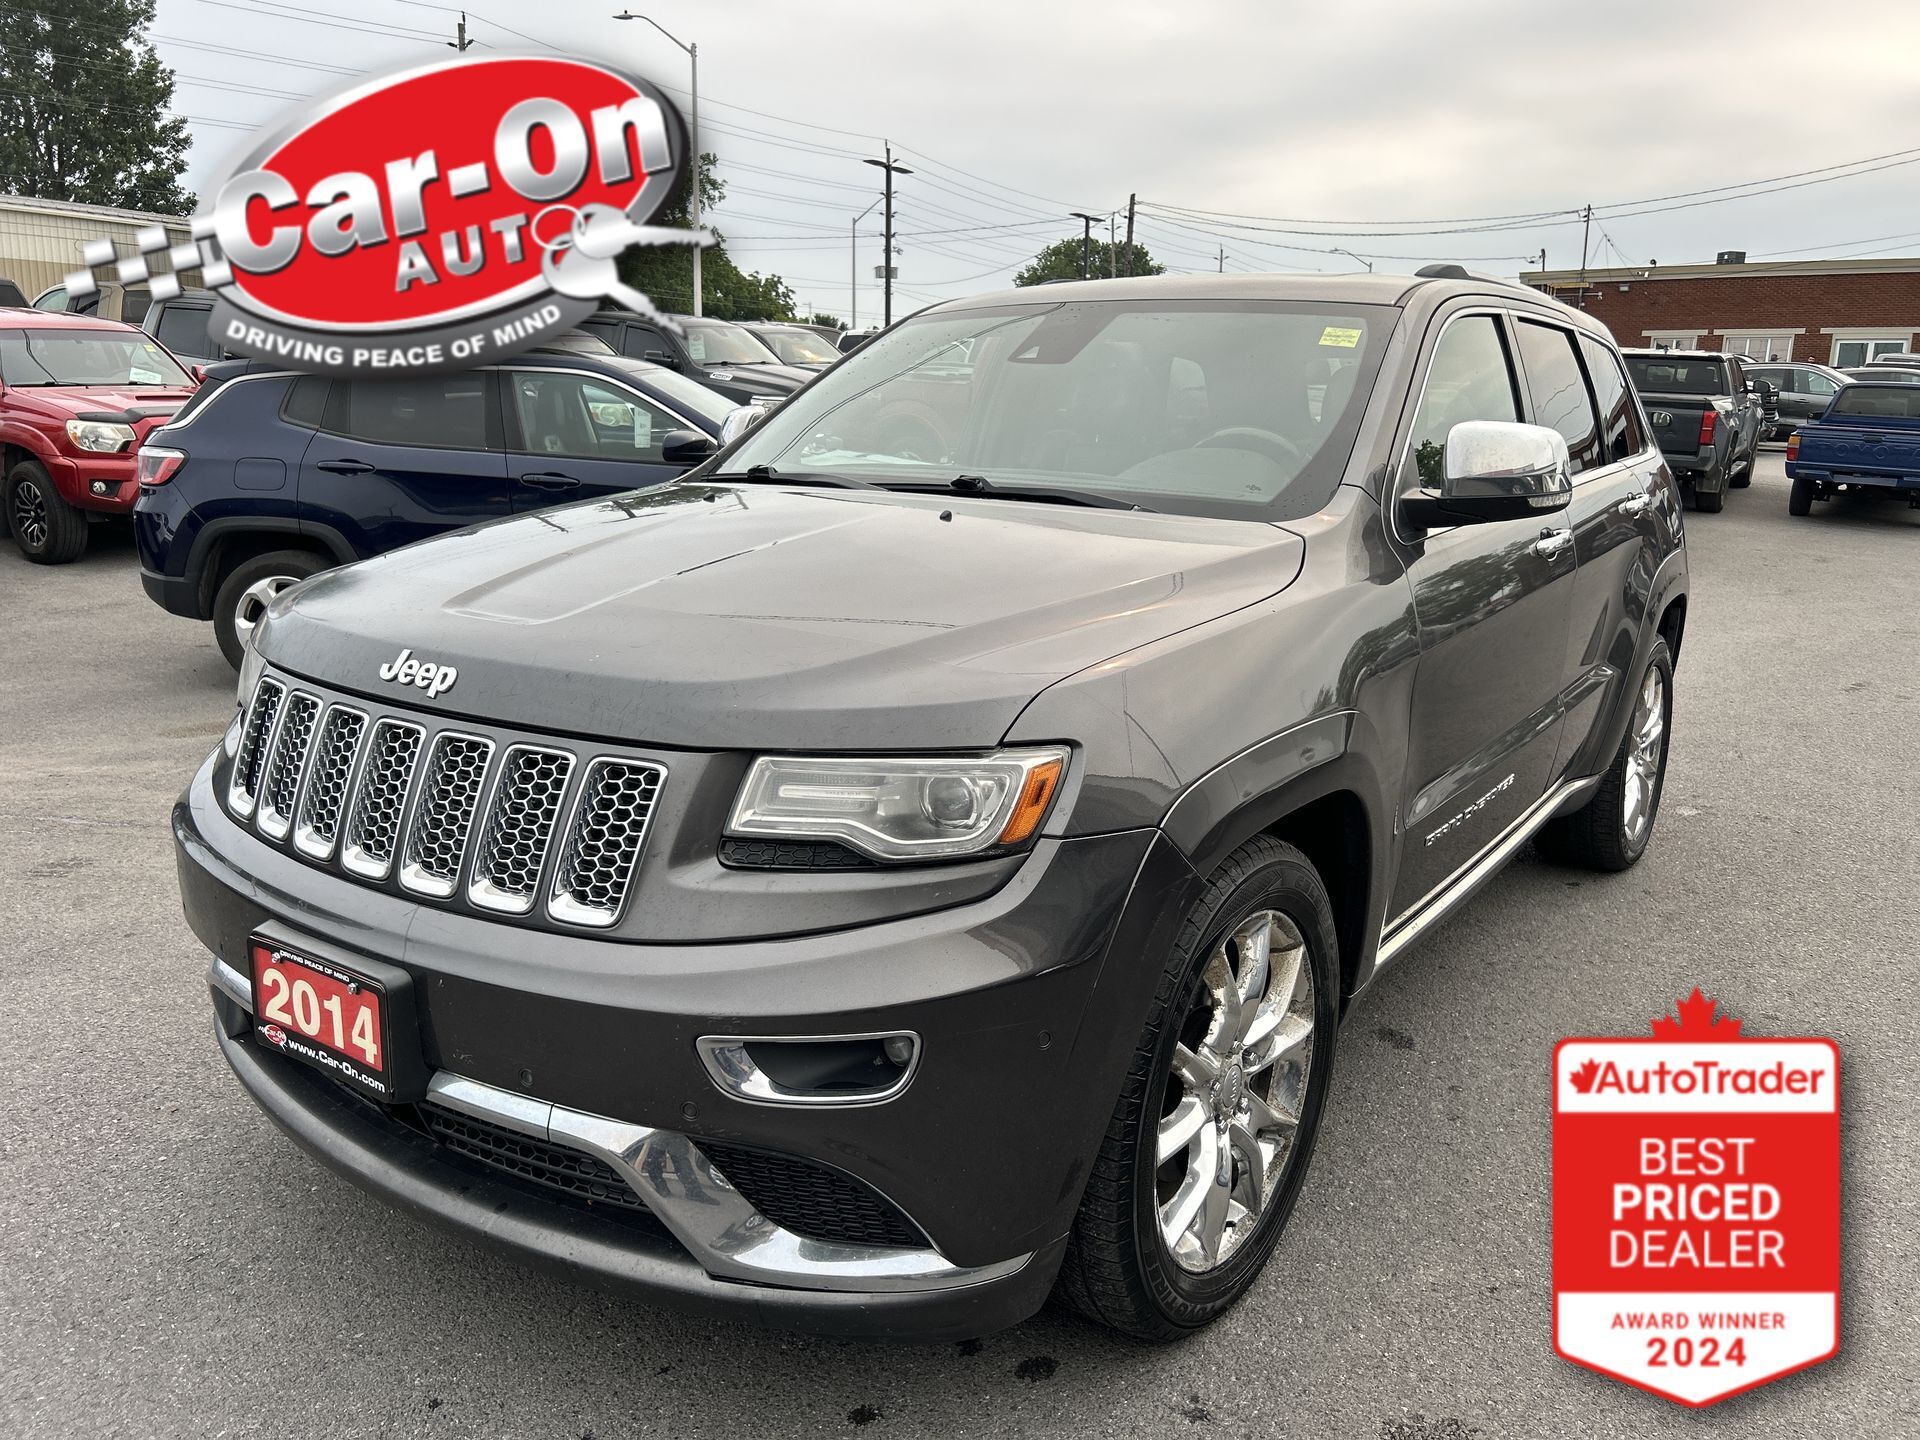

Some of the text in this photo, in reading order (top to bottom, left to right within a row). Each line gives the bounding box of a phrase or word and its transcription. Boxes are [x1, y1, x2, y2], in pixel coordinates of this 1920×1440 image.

[379, 648, 458, 699] Jeep
[279, 949, 350, 983] DRIVING PEACE OF MIND
[262, 967, 378, 1064] 2014
[287, 1039, 385, 1093] www.Car-On.com
